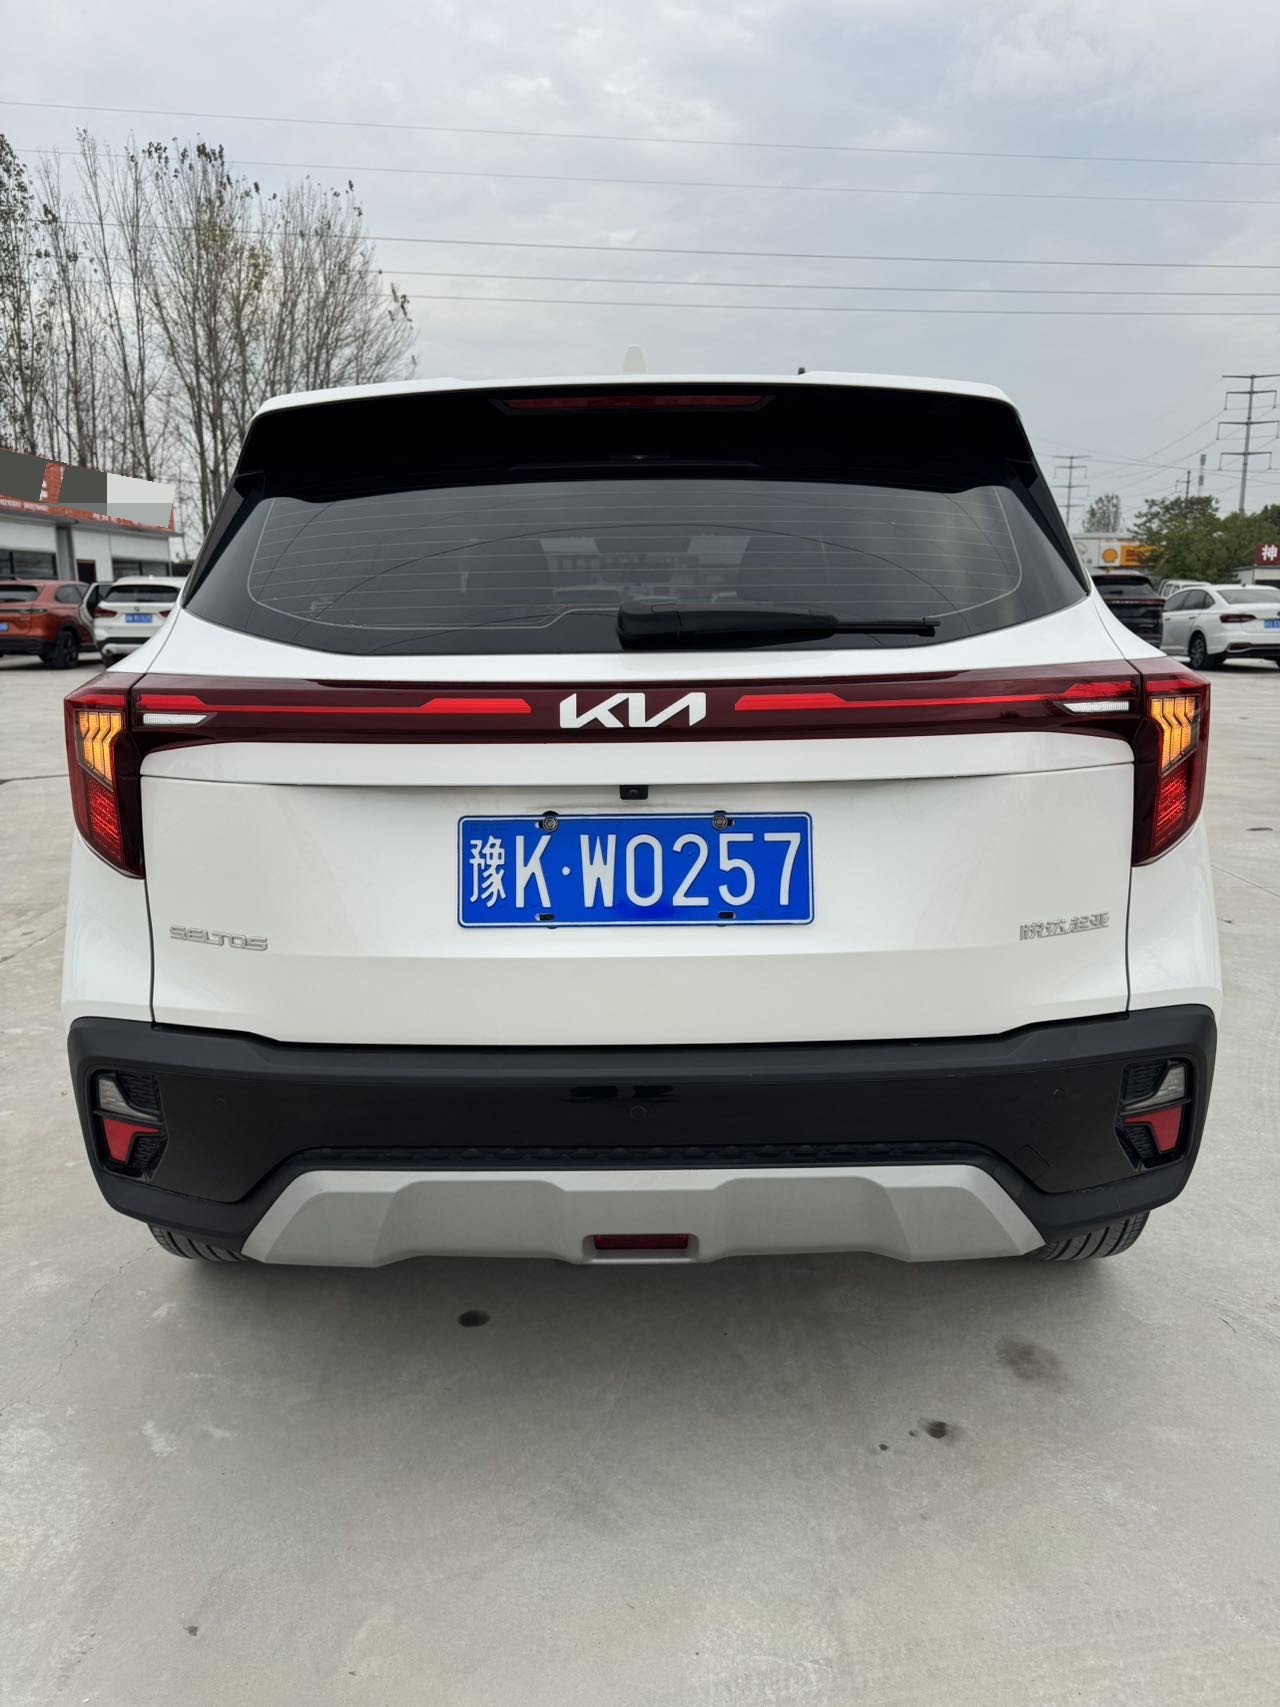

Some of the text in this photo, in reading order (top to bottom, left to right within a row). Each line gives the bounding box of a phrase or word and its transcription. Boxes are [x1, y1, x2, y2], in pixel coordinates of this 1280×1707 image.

[559, 692, 707, 729] KIA
[469, 832, 802, 908] 豫K·W0257
[169, 925, 269, 952] SELTOS
